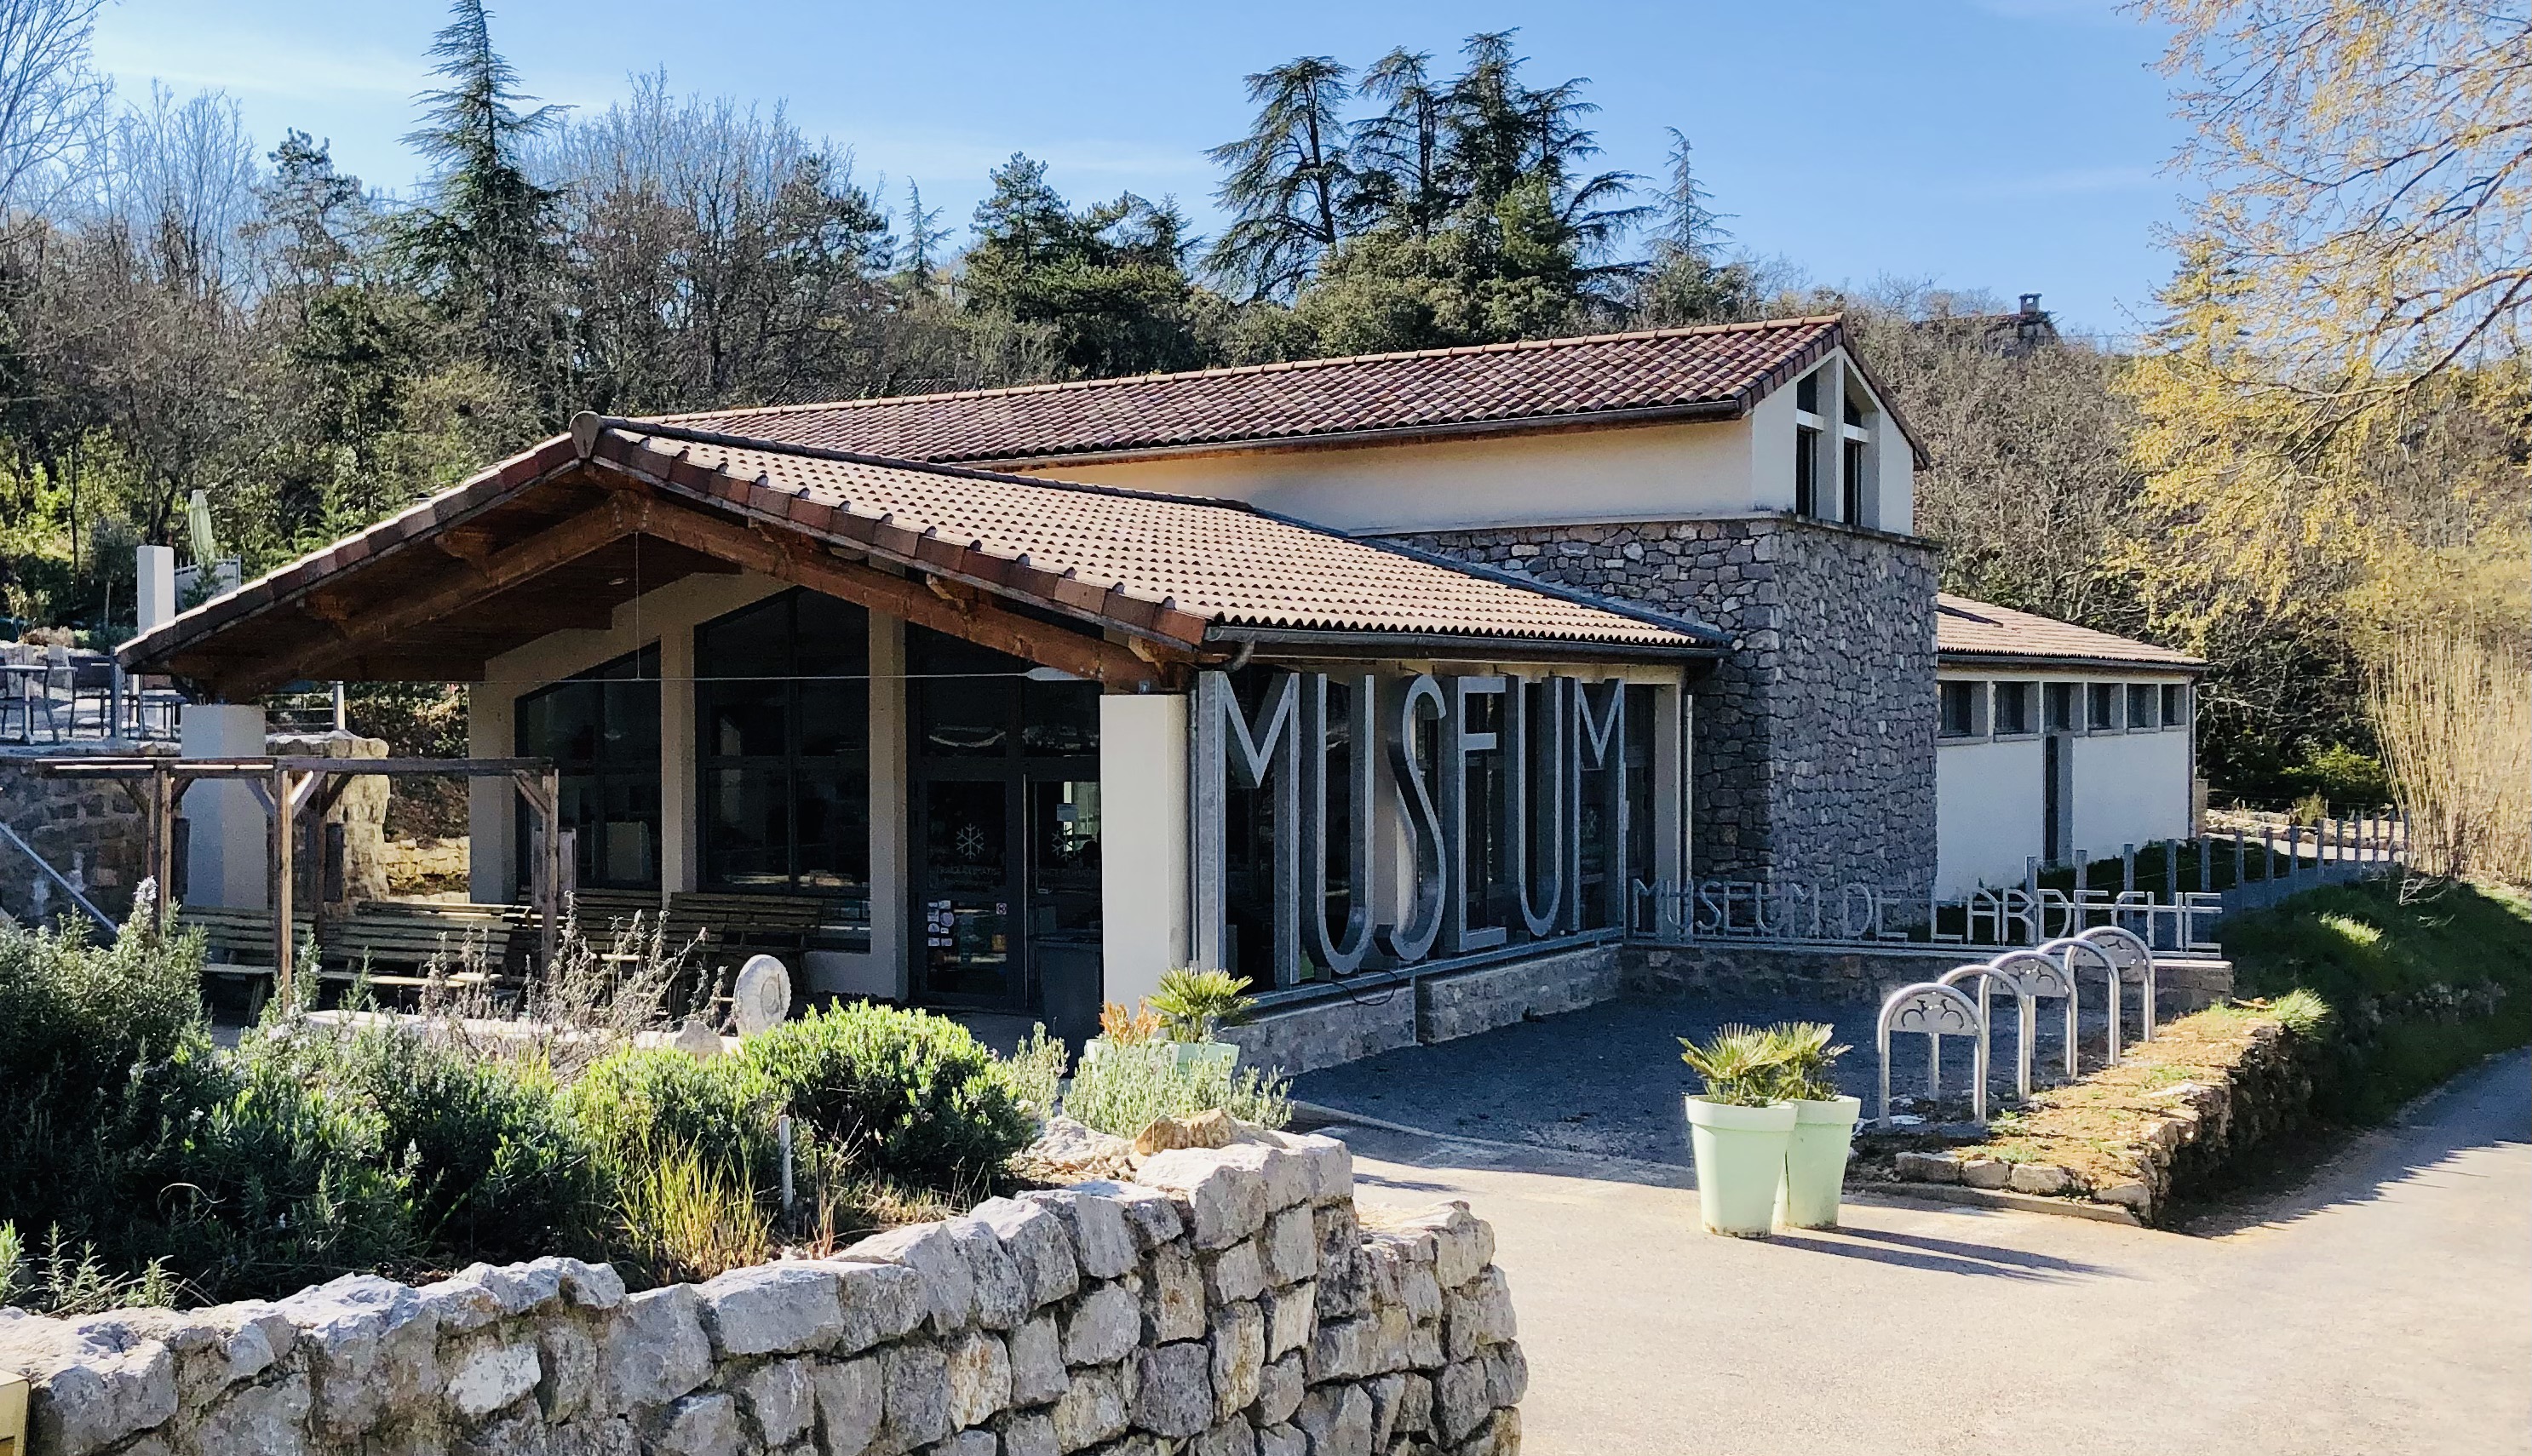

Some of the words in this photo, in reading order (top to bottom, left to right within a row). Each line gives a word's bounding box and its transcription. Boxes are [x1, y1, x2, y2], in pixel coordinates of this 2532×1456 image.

[1200, 670, 1626, 985] MUSEUM
[1633, 878, 1820, 937] MUSEUM
[1843, 883, 1909, 940] DE
